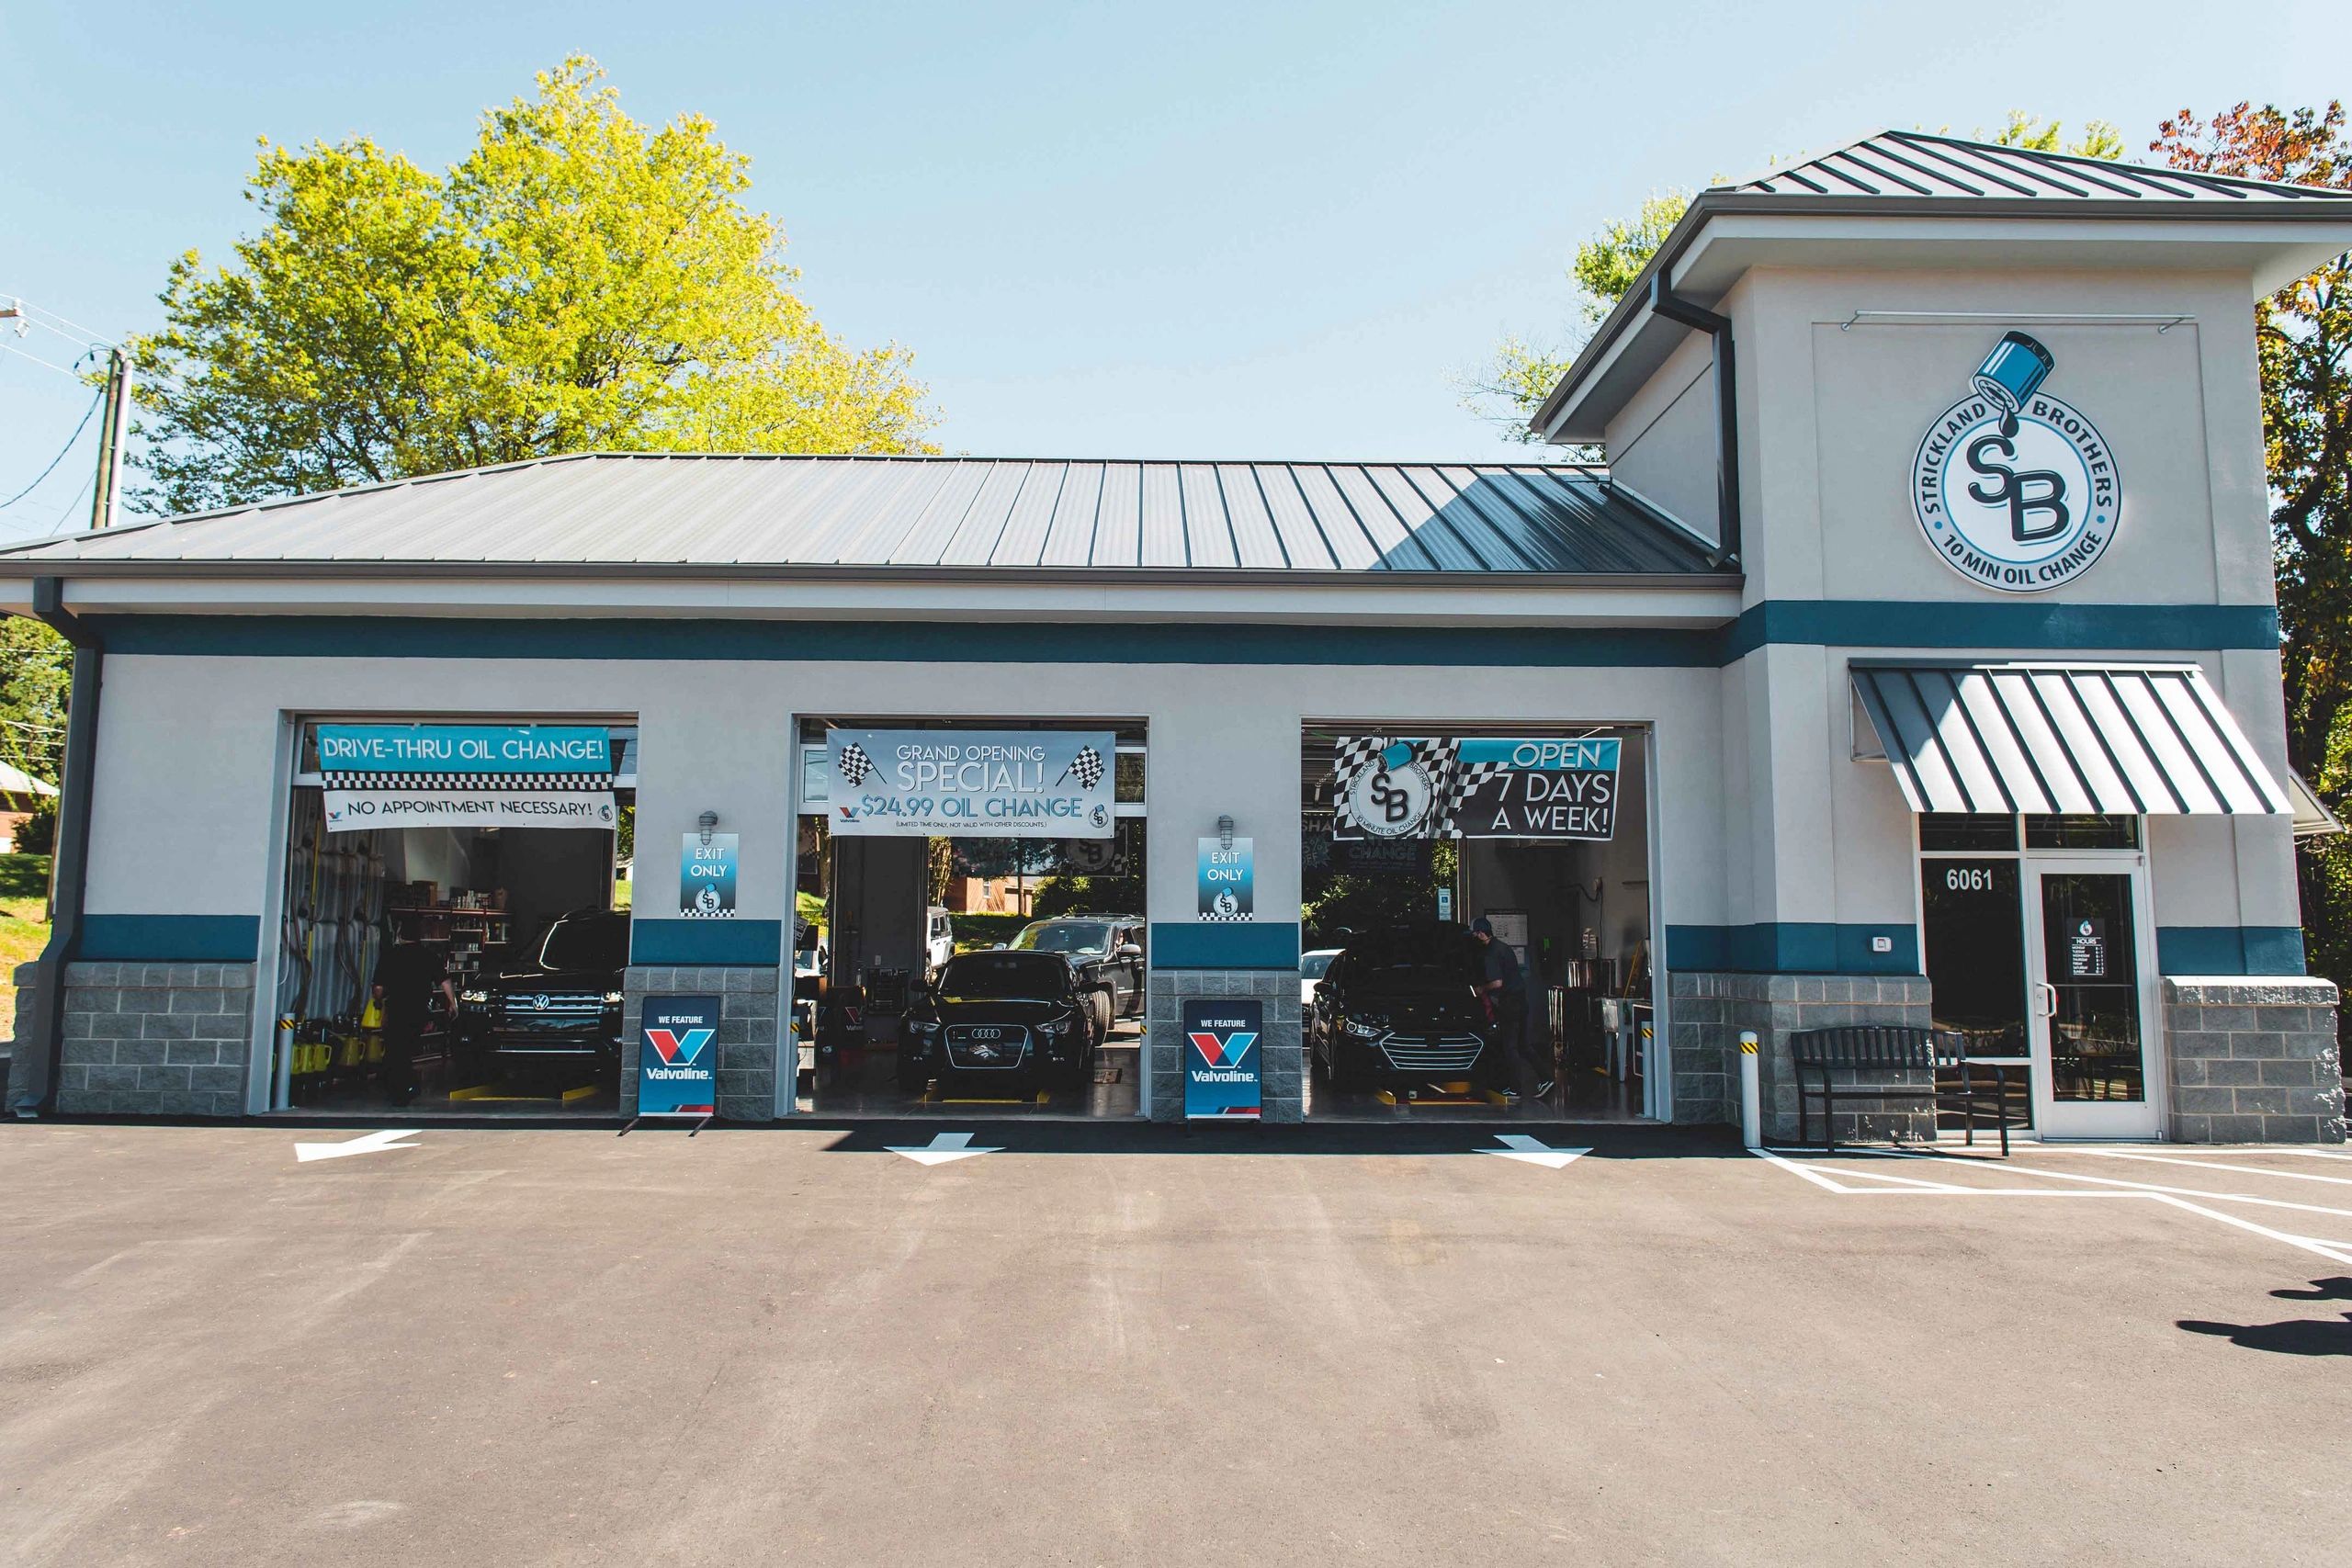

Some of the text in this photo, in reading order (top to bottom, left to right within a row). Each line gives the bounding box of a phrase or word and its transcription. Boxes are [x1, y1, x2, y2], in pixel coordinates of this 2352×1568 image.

[1921, 400, 2112, 514] STRICKLAND BROTHERS
[1943, 530, 2103, 585] 10 MIN OIL CHANGE
[322, 738, 605, 761] DRIVE-THRU OIL CHANGE!
[897, 745, 1046, 761] GRAND OPENING
[1512, 742, 1600, 768] OPEN
[897, 761, 1045, 794] SPECIAL!
[1350, 761, 1430, 795] STRICKLAND BROTHERS
[1495, 773, 1610, 804] 7 DAYS
[348, 800, 592, 817] NO APPOINTMENT NECESSARY!
[862, 794, 1083, 818] $24.99 OIL CHANGE
[1362, 820, 1385, 835] MINUTE
[1398, 812, 1424, 832] CHANGE
[1491, 806, 1608, 833] A WEEK!
[695, 847, 725, 860] EXIT
[1211, 852, 1240, 864] EXIT
[690, 864, 728, 878] ONLY
[1207, 868, 1244, 882] ONLY
[1946, 868, 1993, 890] 6061
[658, 1015, 704, 1023] WE FEATURE
[1214, 1020, 1246, 1028] FEATURE
[646, 1067, 709, 1080] Valvoline
[1191, 1070, 1255, 1082] Valvoline
